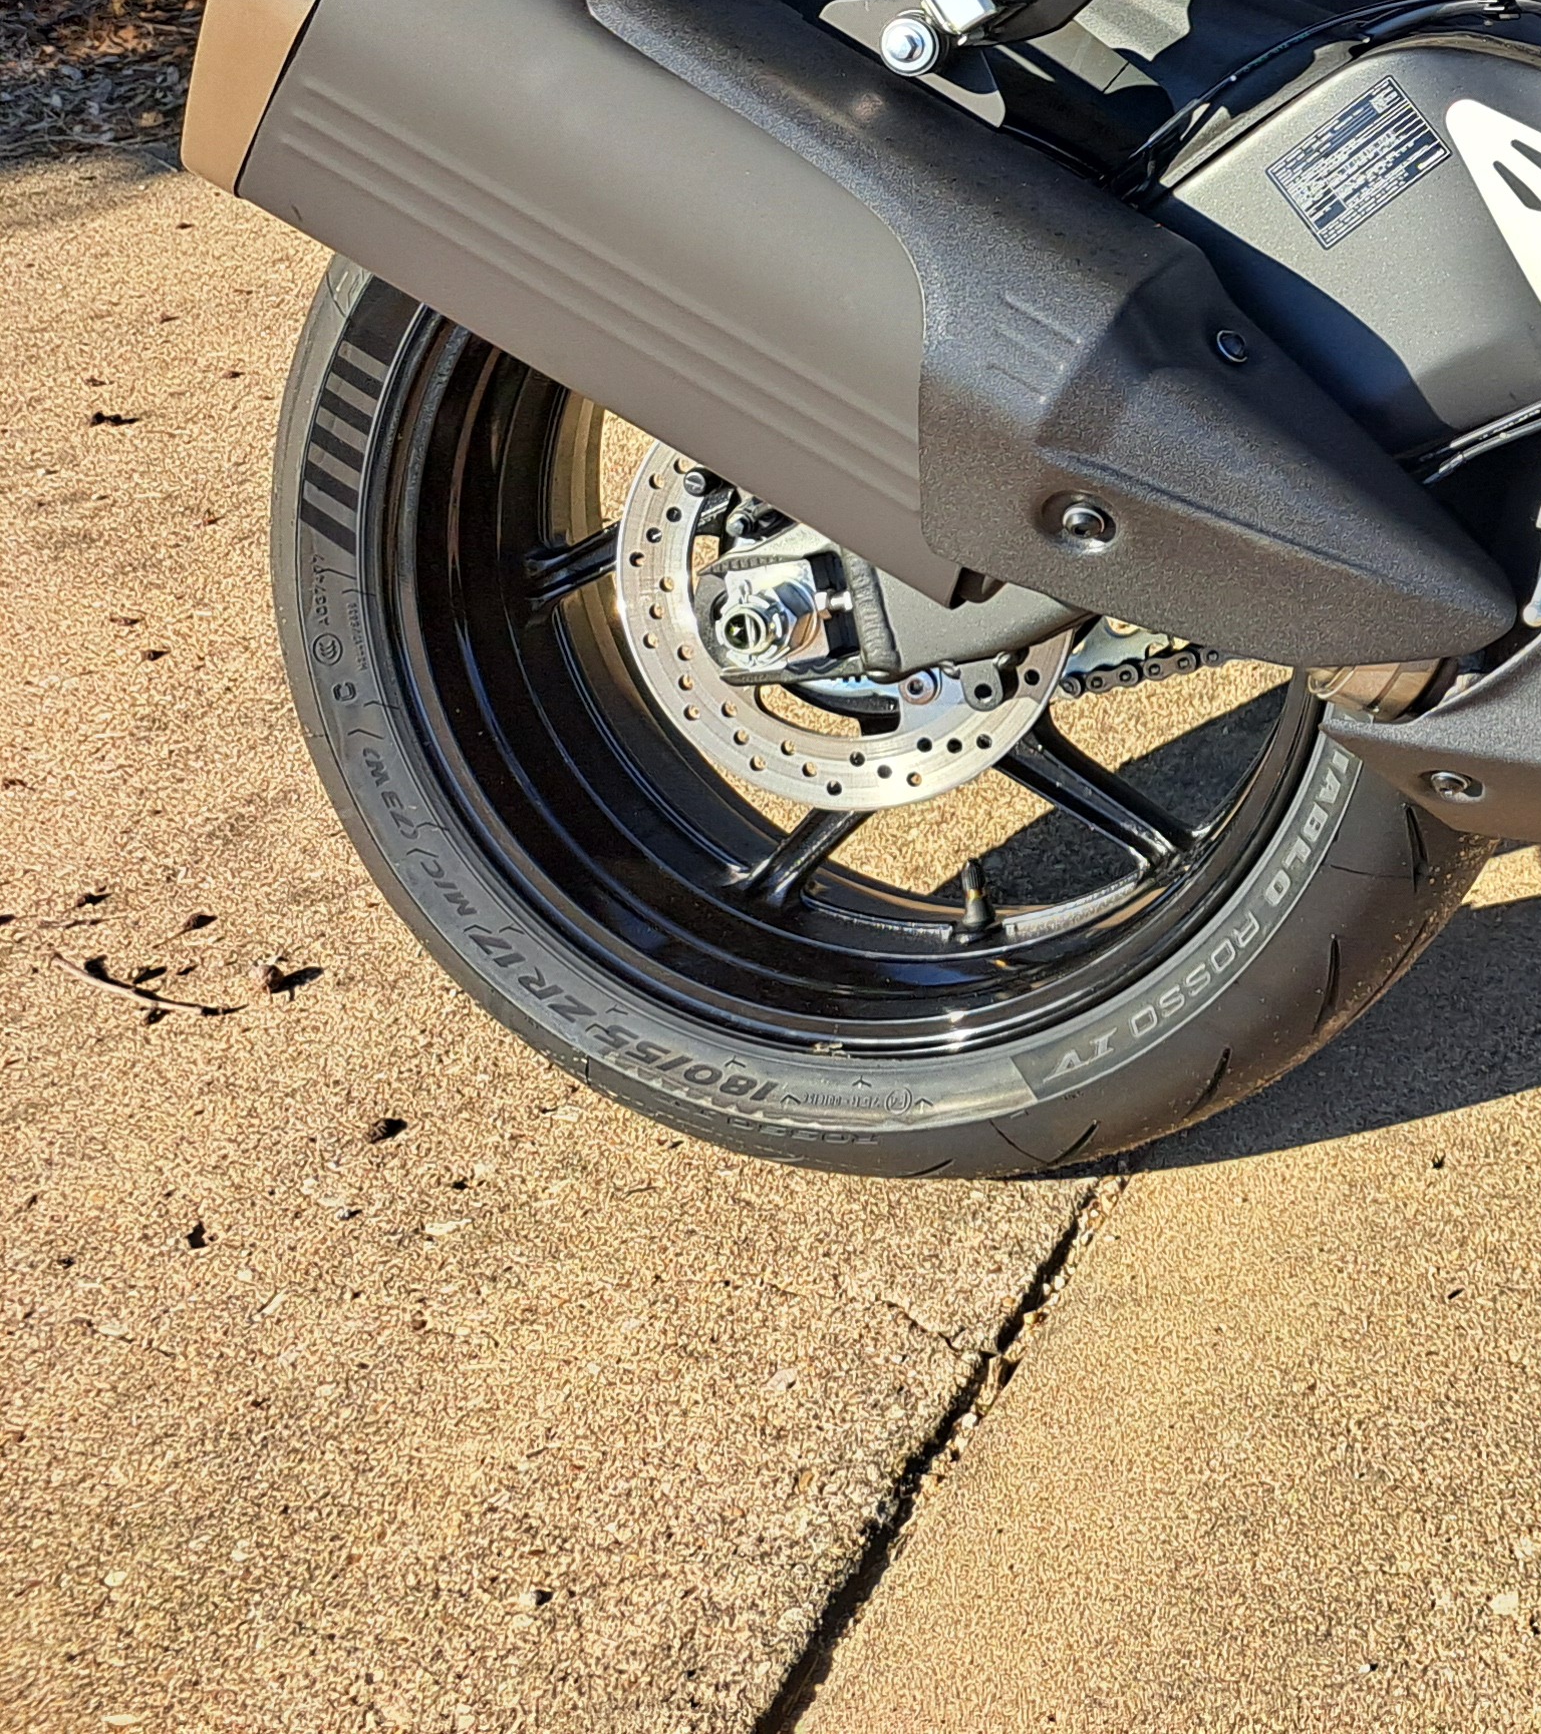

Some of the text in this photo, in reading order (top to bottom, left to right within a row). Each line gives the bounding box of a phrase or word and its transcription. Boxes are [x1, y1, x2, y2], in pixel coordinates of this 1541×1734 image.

[1042, 732, 1362, 1084] IABLO ROSSO IV
[592, 1024, 778, 1102] 180/55
